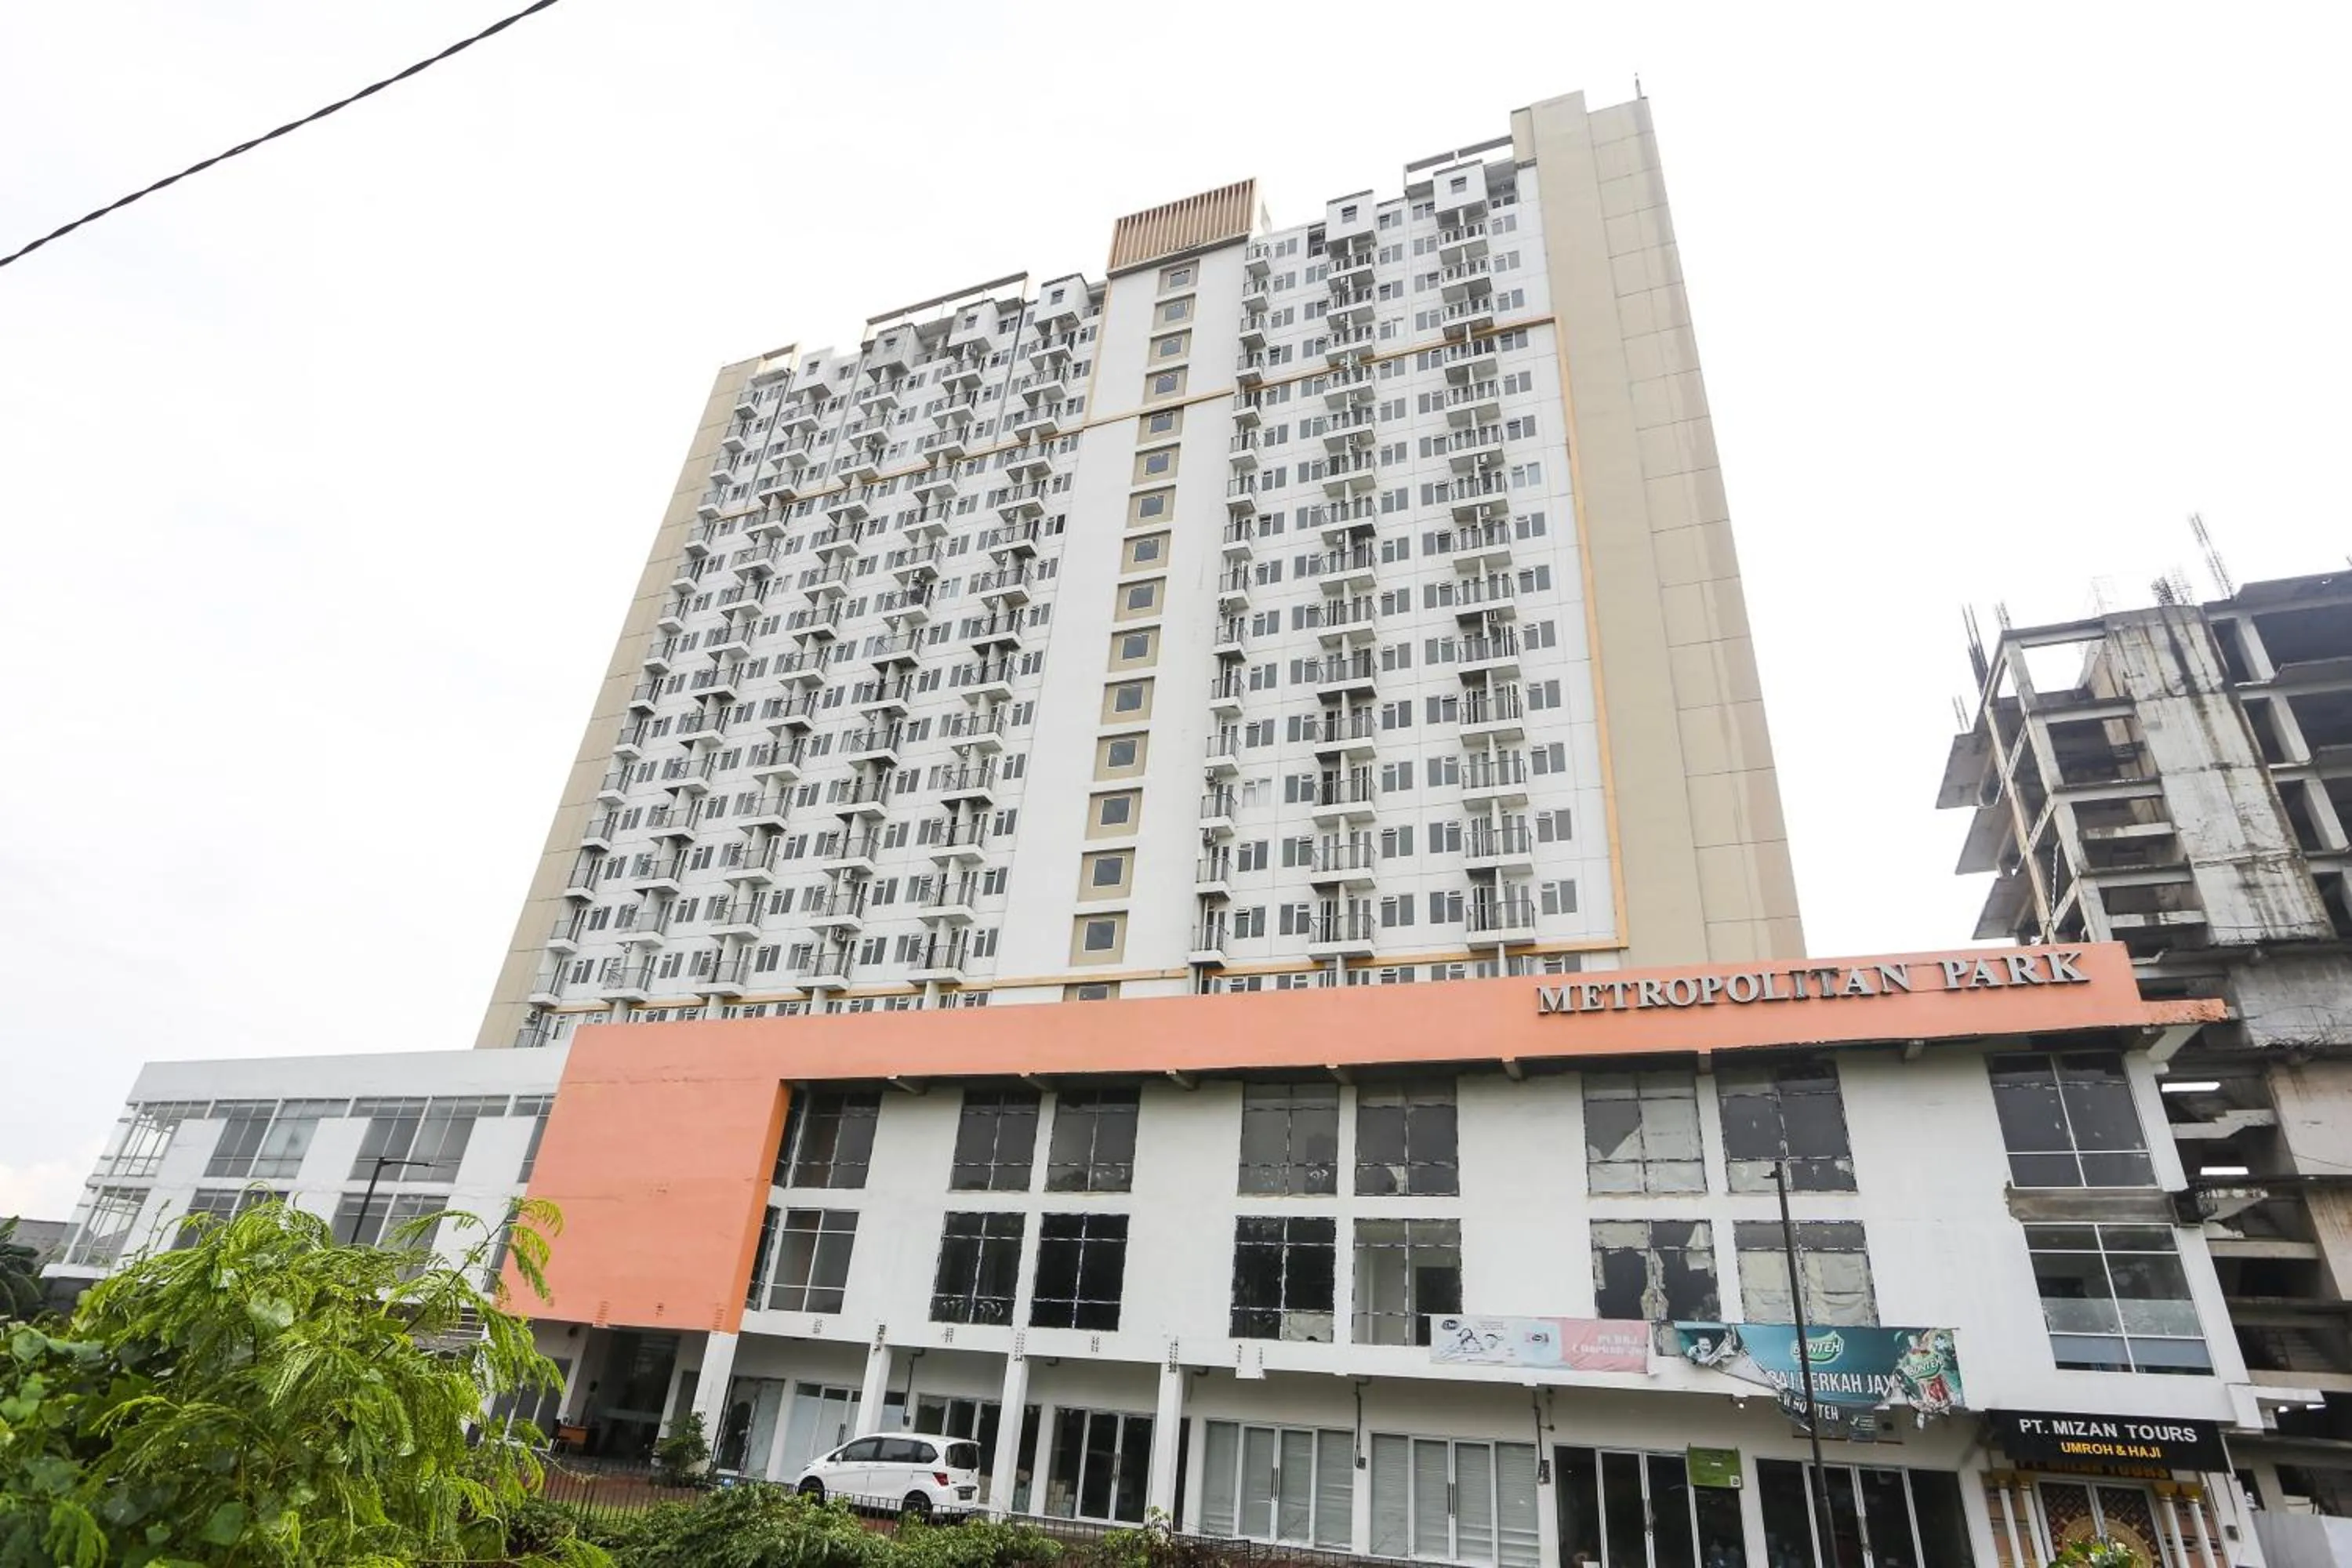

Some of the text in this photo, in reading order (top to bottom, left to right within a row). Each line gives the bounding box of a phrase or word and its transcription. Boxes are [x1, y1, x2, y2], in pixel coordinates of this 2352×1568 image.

[1537, 951, 2091, 1015] METROPOLITAN PARK
[1793, 1336, 1840, 1355] BNTEH
[2019, 1418, 2198, 1443] PT. MIZAN TOURS
[2060, 1442, 2161, 1458] UMROH & HAJI
